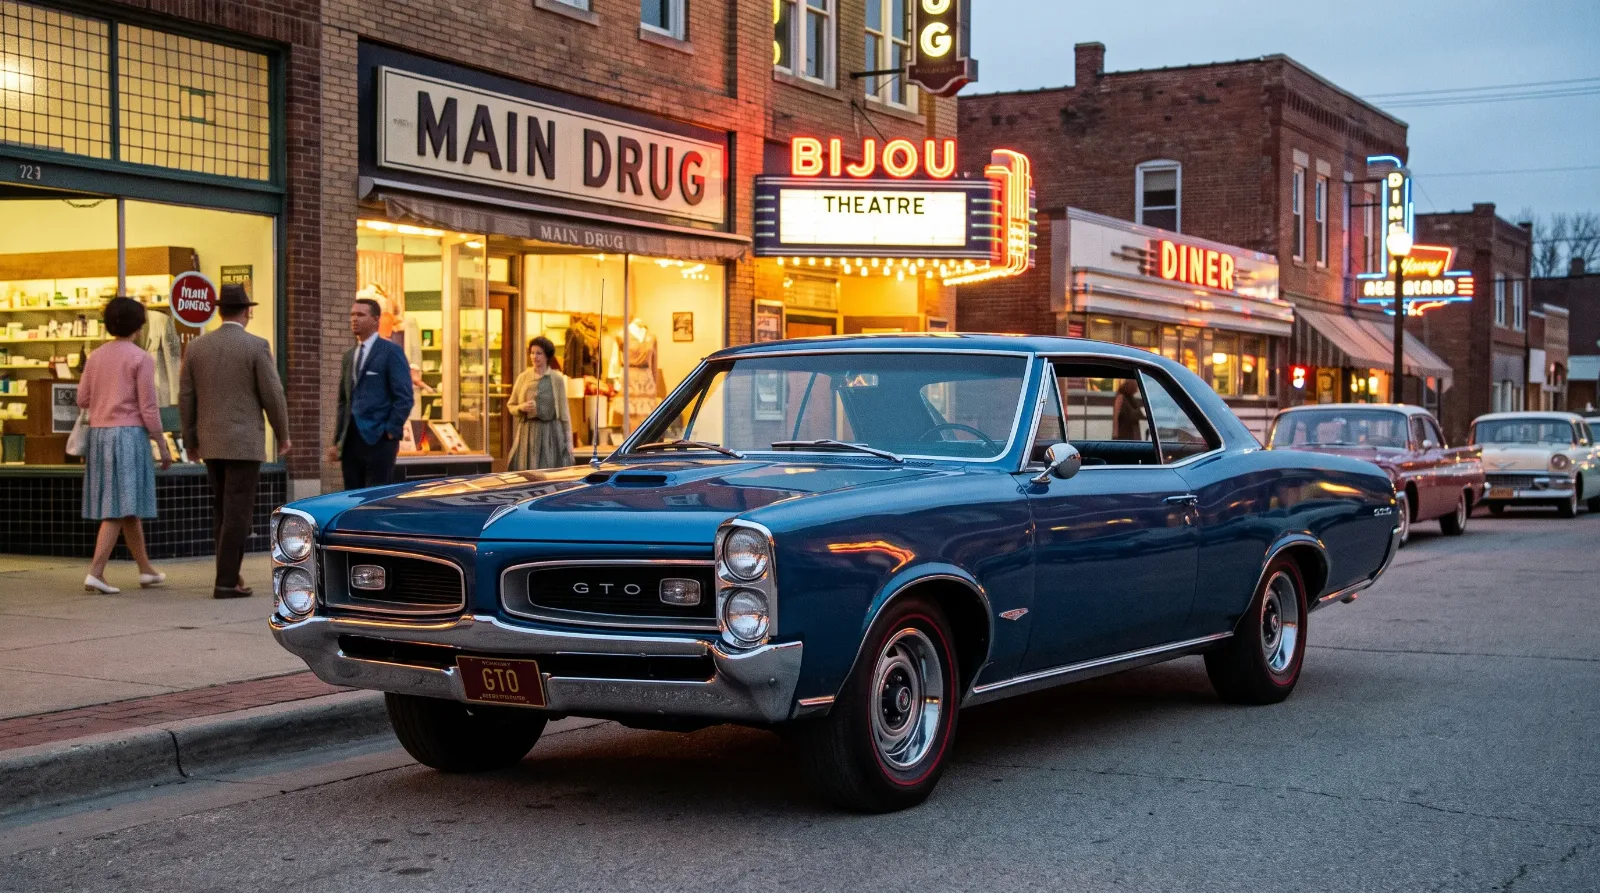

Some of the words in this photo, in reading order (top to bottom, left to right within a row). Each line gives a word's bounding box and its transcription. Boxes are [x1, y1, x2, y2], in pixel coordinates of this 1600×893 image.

[417, 90, 555, 180] MAIN
[584, 128, 705, 206] DRUG
[791, 137, 956, 179] BIJOU
[824, 195, 925, 215] THEATRE
[541, 225, 579, 243] MAIN
[584, 231, 624, 249] DRUG
[1161, 240, 1235, 290] DINER
[573, 582, 641, 595] GTO
[482, 667, 519, 693] GTO
